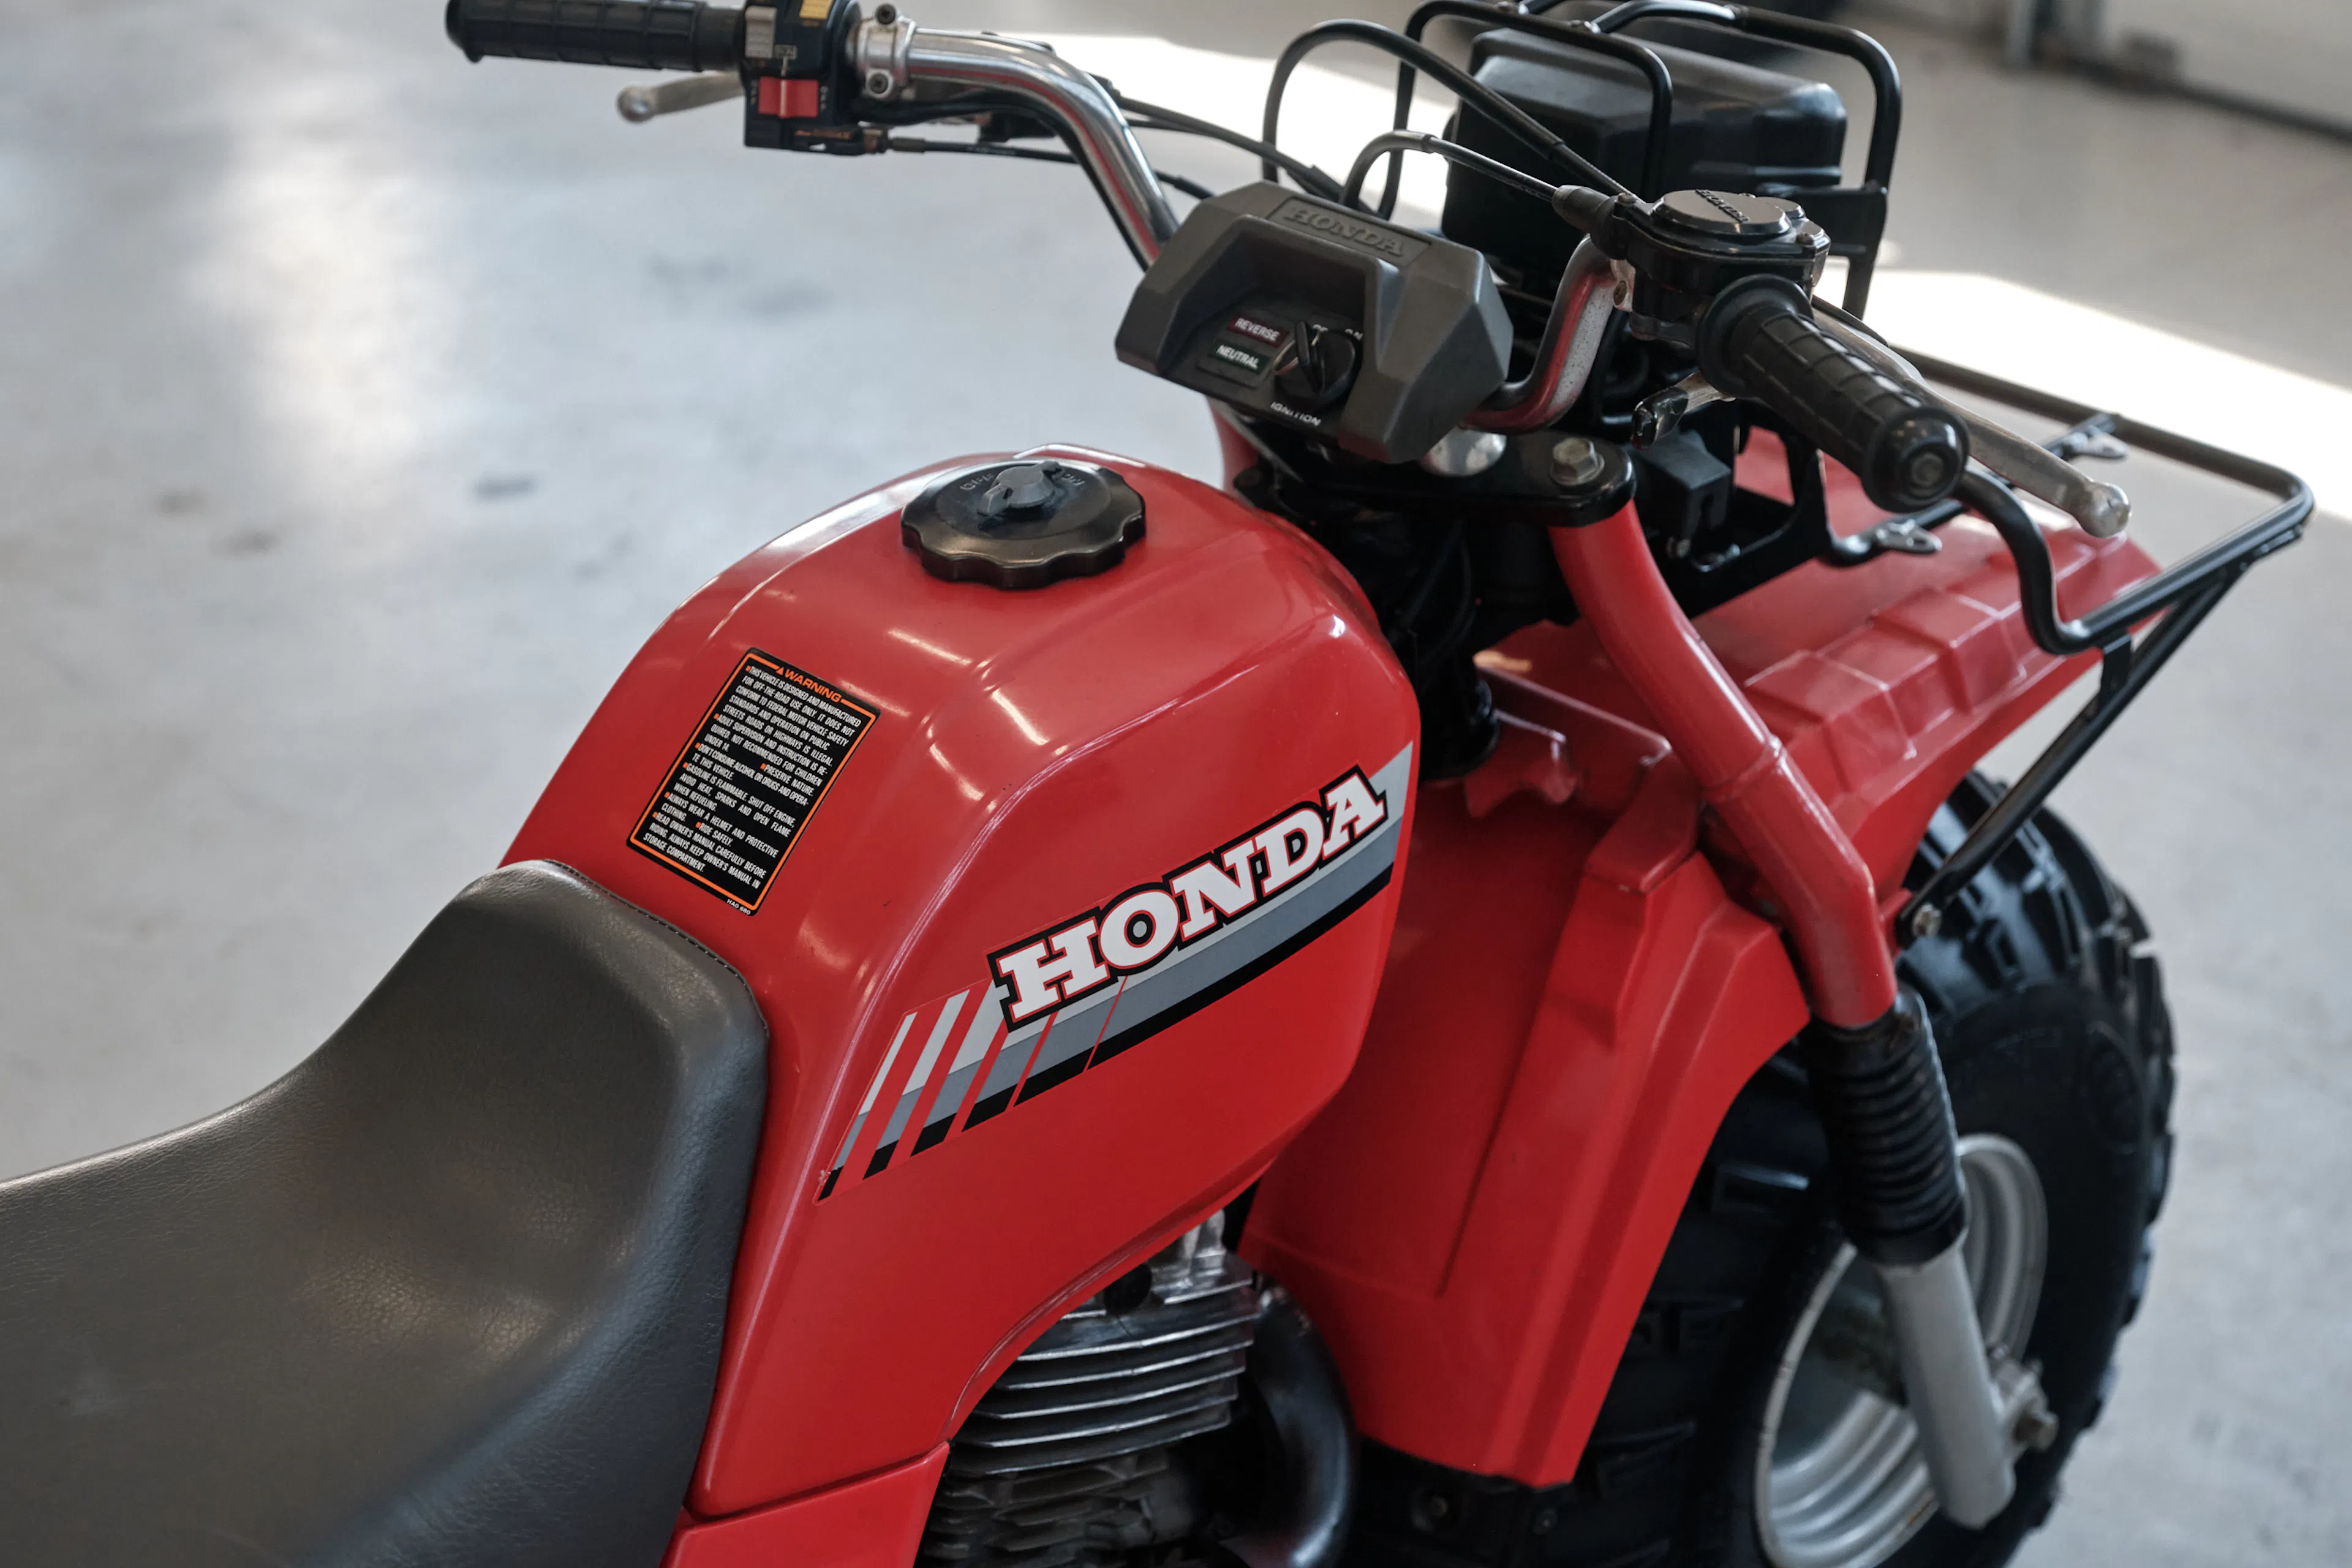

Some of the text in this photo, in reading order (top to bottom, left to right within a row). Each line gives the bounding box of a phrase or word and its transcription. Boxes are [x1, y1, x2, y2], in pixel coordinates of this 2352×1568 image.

[1284, 206, 1404, 257] HONDA
[1234, 318, 1280, 342] REVERSE
[1216, 345, 1260, 370] NEUTRAL
[1270, 402, 1322, 426] IGNITION
[741, 676, 855, 737] FOR OFF-THE-ROAD USE ONLY. IT DOES NOT
[748, 666, 862, 727] THIS VEHICLE IS DESIGNED AND MANUFACTURED
[784, 669, 842, 703] WARNING
[704, 733, 731, 752] UNDER 14.
[716, 714, 733, 727] ADULT
[732, 722, 765, 744] SUPERVISION
[763, 738, 777, 750] AND
[775, 744, 811, 767] INSTRUCTION
[809, 762, 818, 771] IS
[722, 704, 835, 766] STREETS ROADS OR HIGHWAYS IS ILLEGAL.
[728, 695, 830, 750] STANDARDS AND OPERATION ON PUBLIC
[735, 685, 849, 747] CONFORM TO FEDERAL MOTOR VEHICLE SAFETY
[692, 753, 736, 780] TE THIS VEHICLE.
[697, 743, 714, 756] DON'T
[710, 750, 736, 767] CONSUME
[733, 761, 756, 778] ALCOHOL
[753, 772, 764, 782] OR
[760, 776, 780, 791] DRUGS
[777, 785, 791, 797] AND
[710, 723, 823, 786] QUIRED. NOT RECOMMENDED FOR CHILDREN
[763, 764, 816, 796] PRESERVE NATURE.
[661, 802, 688, 821] CLOTHING.
[673, 782, 719, 812] WHEN REFUELING.
[679, 772, 791, 837] AVOID HEAT, SPARKS AND OPEN FLAME
[685, 763, 797, 827] GASOLINE IS FLAMMABLE. SHUT OFF ENGINE,
[643, 832, 707, 872] STORAGE COMPARTMENT.
[655, 812, 766, 878] READ OWNER'S MANUAL CAREFULLY BEFORE
[667, 792, 778, 858] ALWAYS WEAR A HELMET AND PROTECTIVE
[698, 823, 734, 846] RIDE SAFELY.
[649, 822, 761, 889] RIDING. ALWAYS KEEP OWNER'S MANUAL IN
[739, 906, 751, 915] 680
[995, 771, 1387, 1025] HONDA
